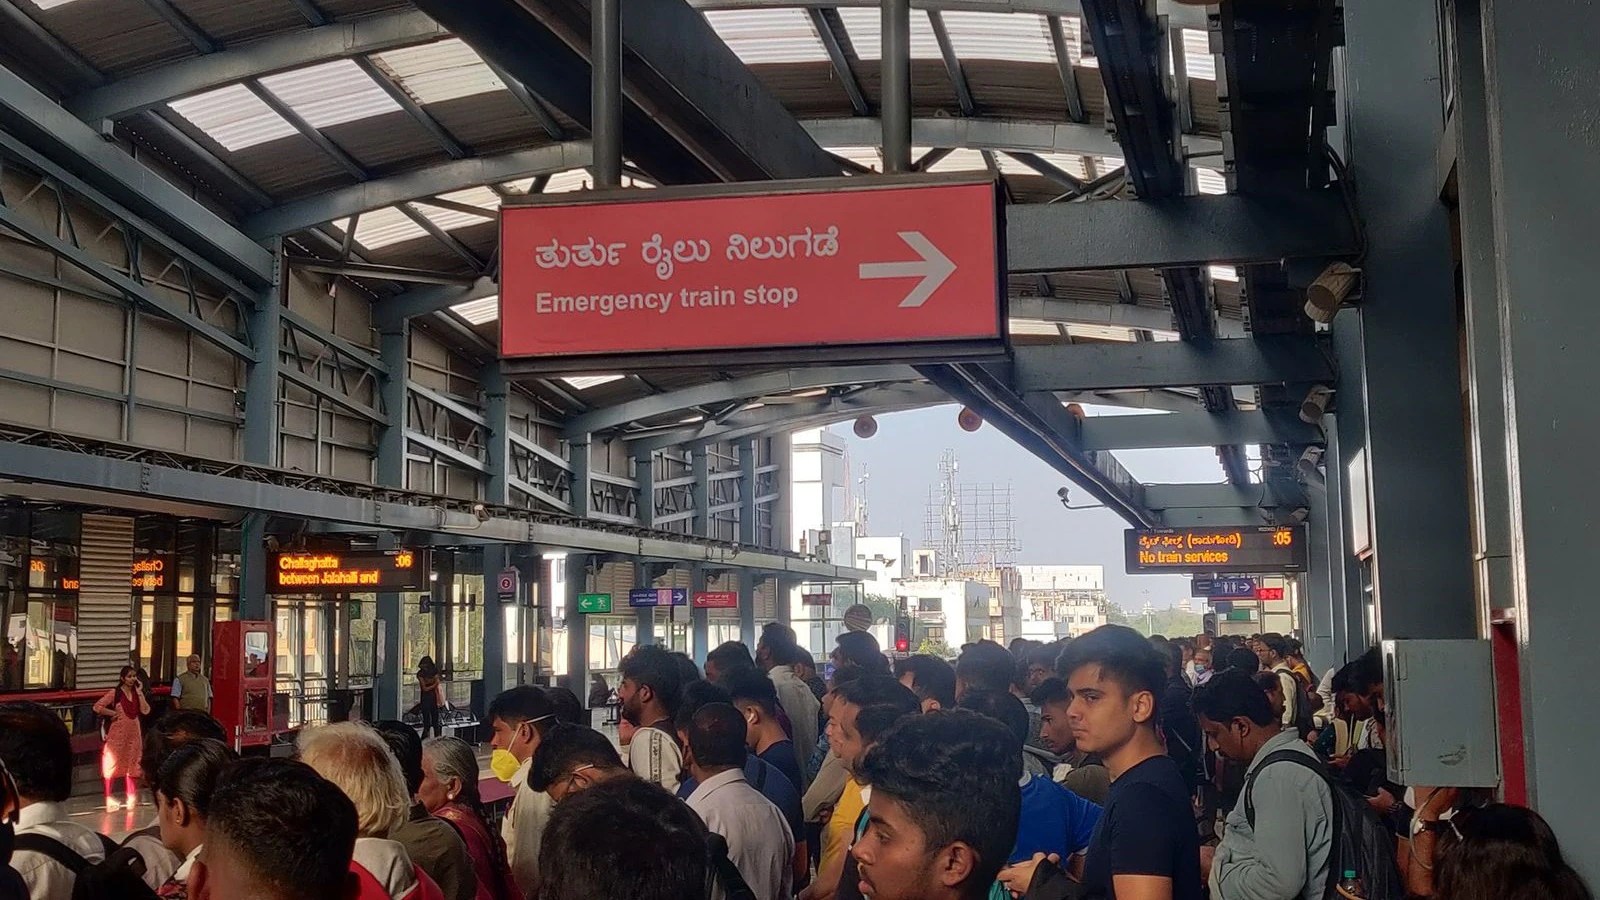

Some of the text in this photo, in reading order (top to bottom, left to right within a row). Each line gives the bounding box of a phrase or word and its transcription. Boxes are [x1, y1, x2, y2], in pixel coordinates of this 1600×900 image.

[535, 225, 839, 280] ತುರ್ತು ರೈಲು ನಿಲುಗಡೆ
[535, 284, 798, 316] Emergency train stop
[1139, 550, 1228, 563] No train services
[279, 557, 339, 571] Challaghatta
[279, 571, 379, 585] between Jalahalli and
